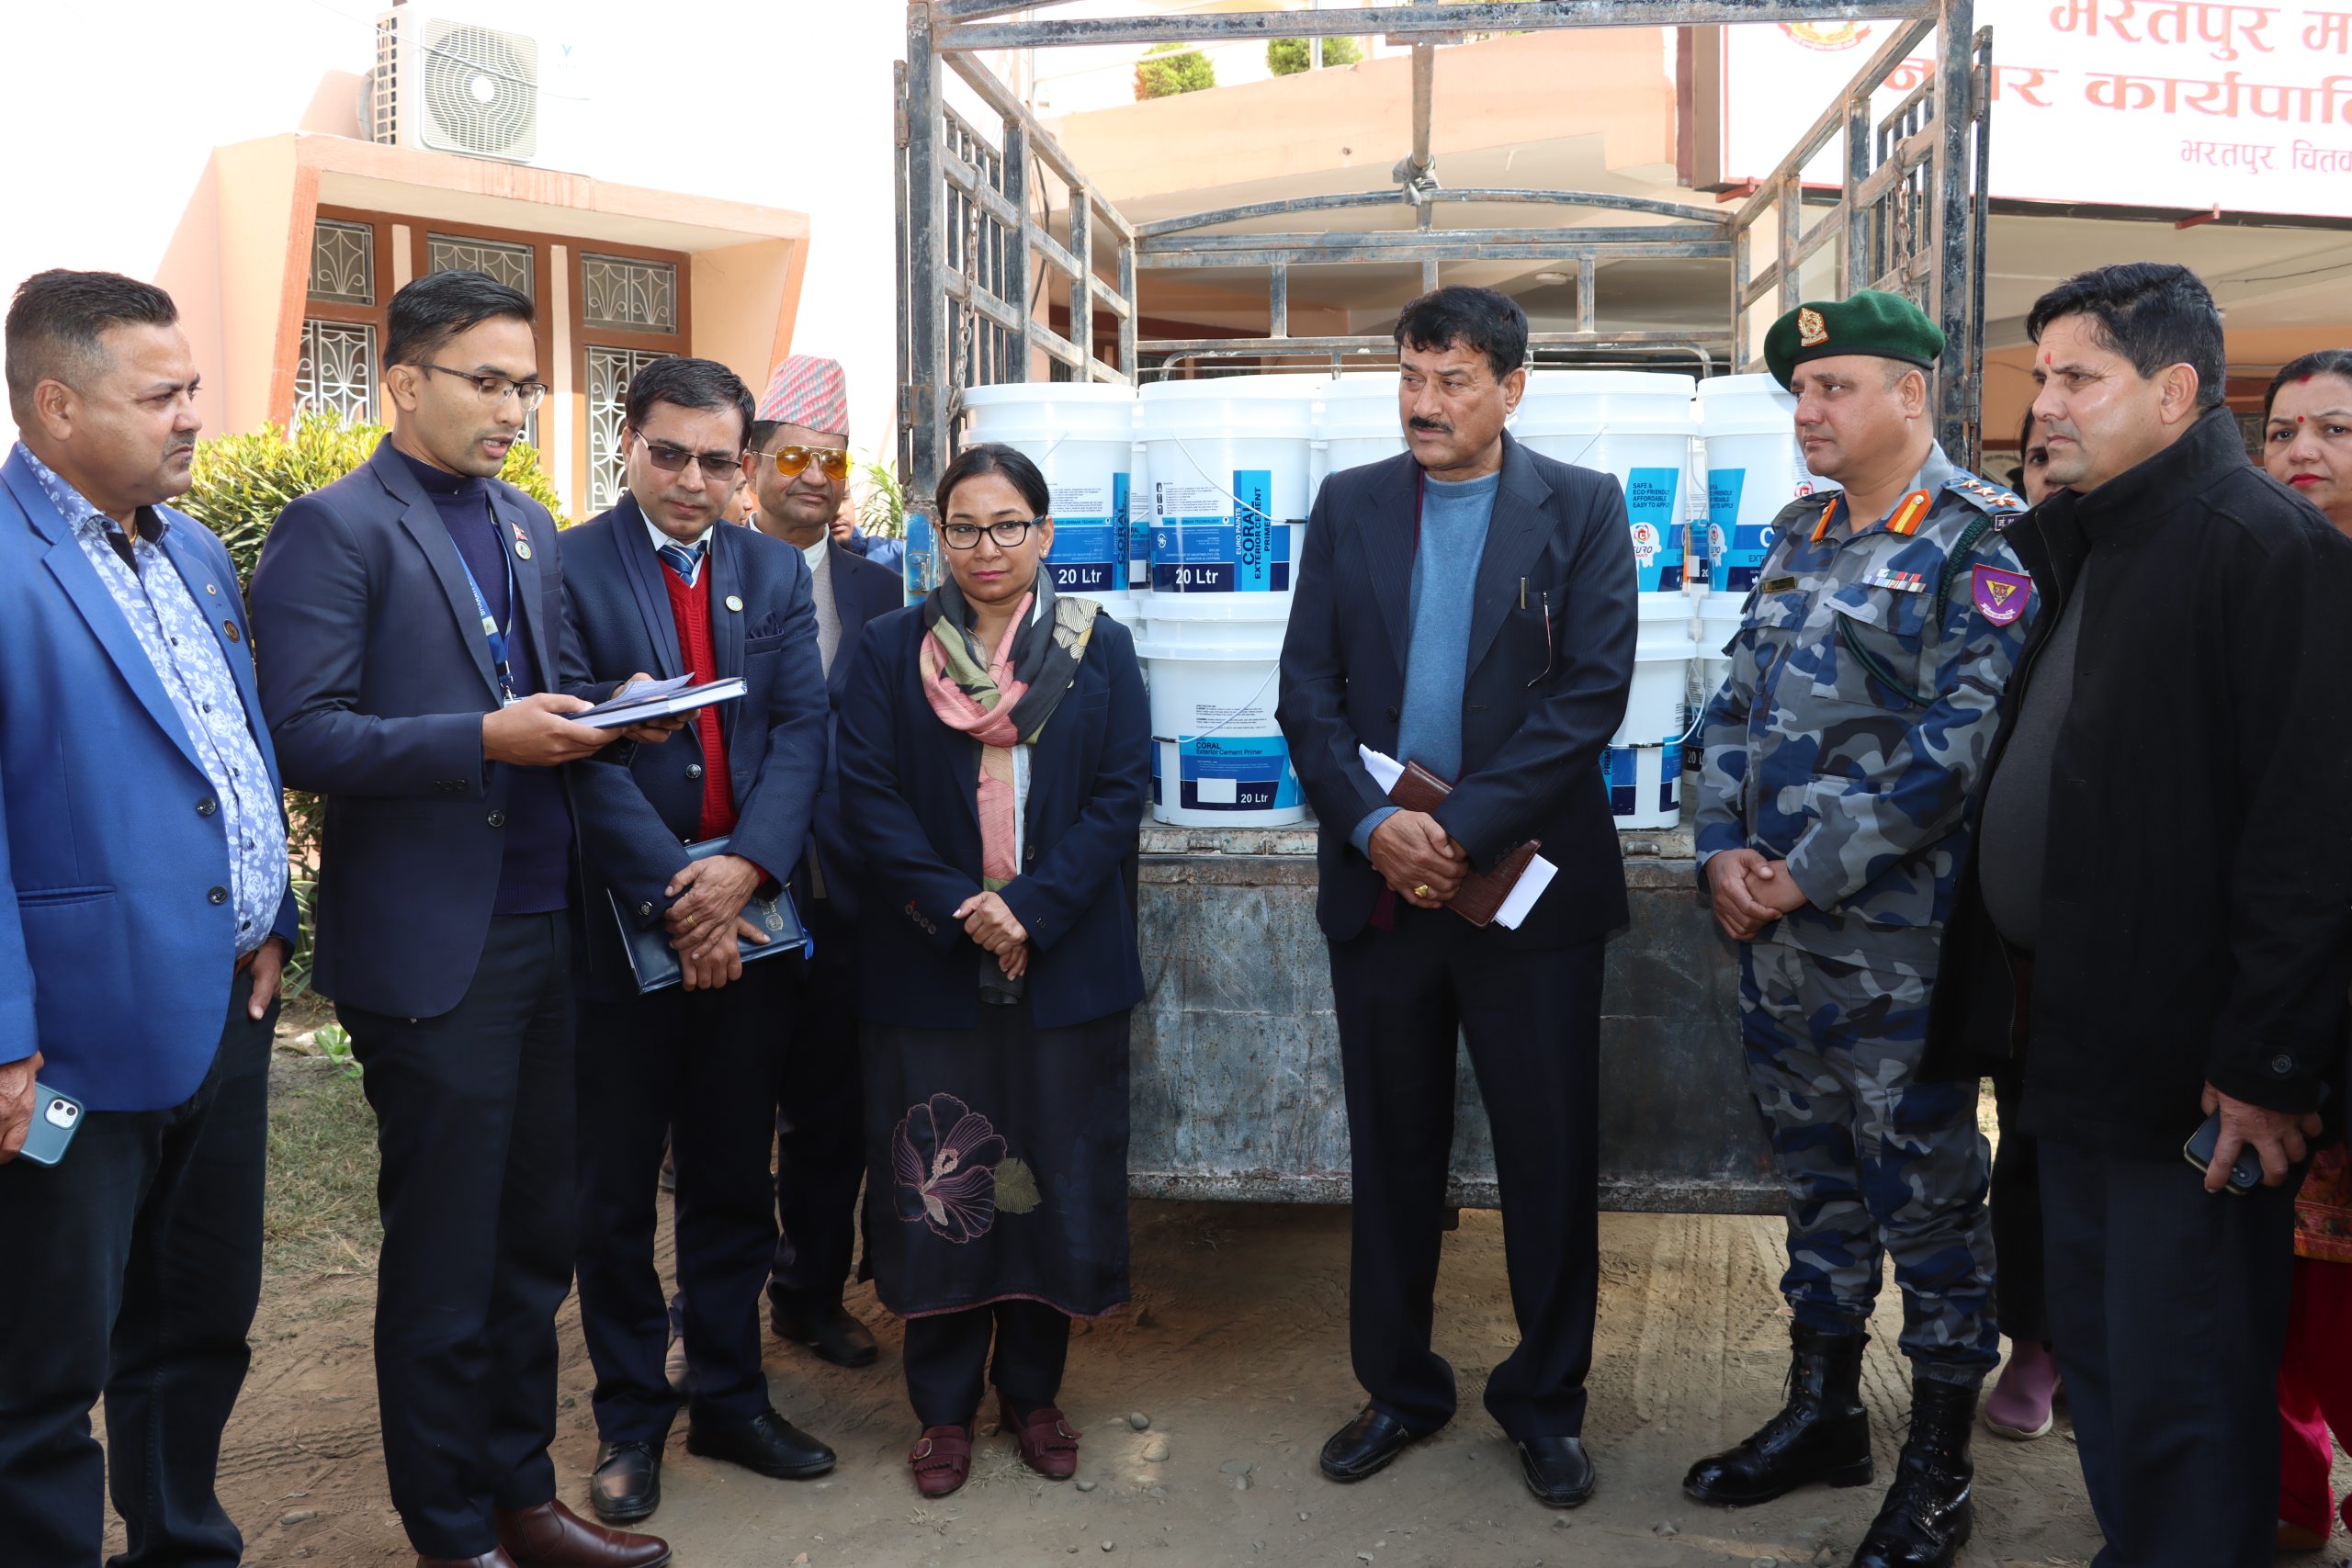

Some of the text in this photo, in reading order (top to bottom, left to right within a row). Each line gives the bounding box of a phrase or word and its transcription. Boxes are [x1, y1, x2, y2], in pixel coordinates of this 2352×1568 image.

[1242, 502, 1254, 565] CORAL
[1057, 569, 1102, 584] 20 Ltr
[1175, 569, 1219, 584] 20 Ltr
[1195, 741, 1221, 750] CORAL
[1687, 751, 1697, 764] 20
[1240, 793, 1269, 805] 20 Ltr
